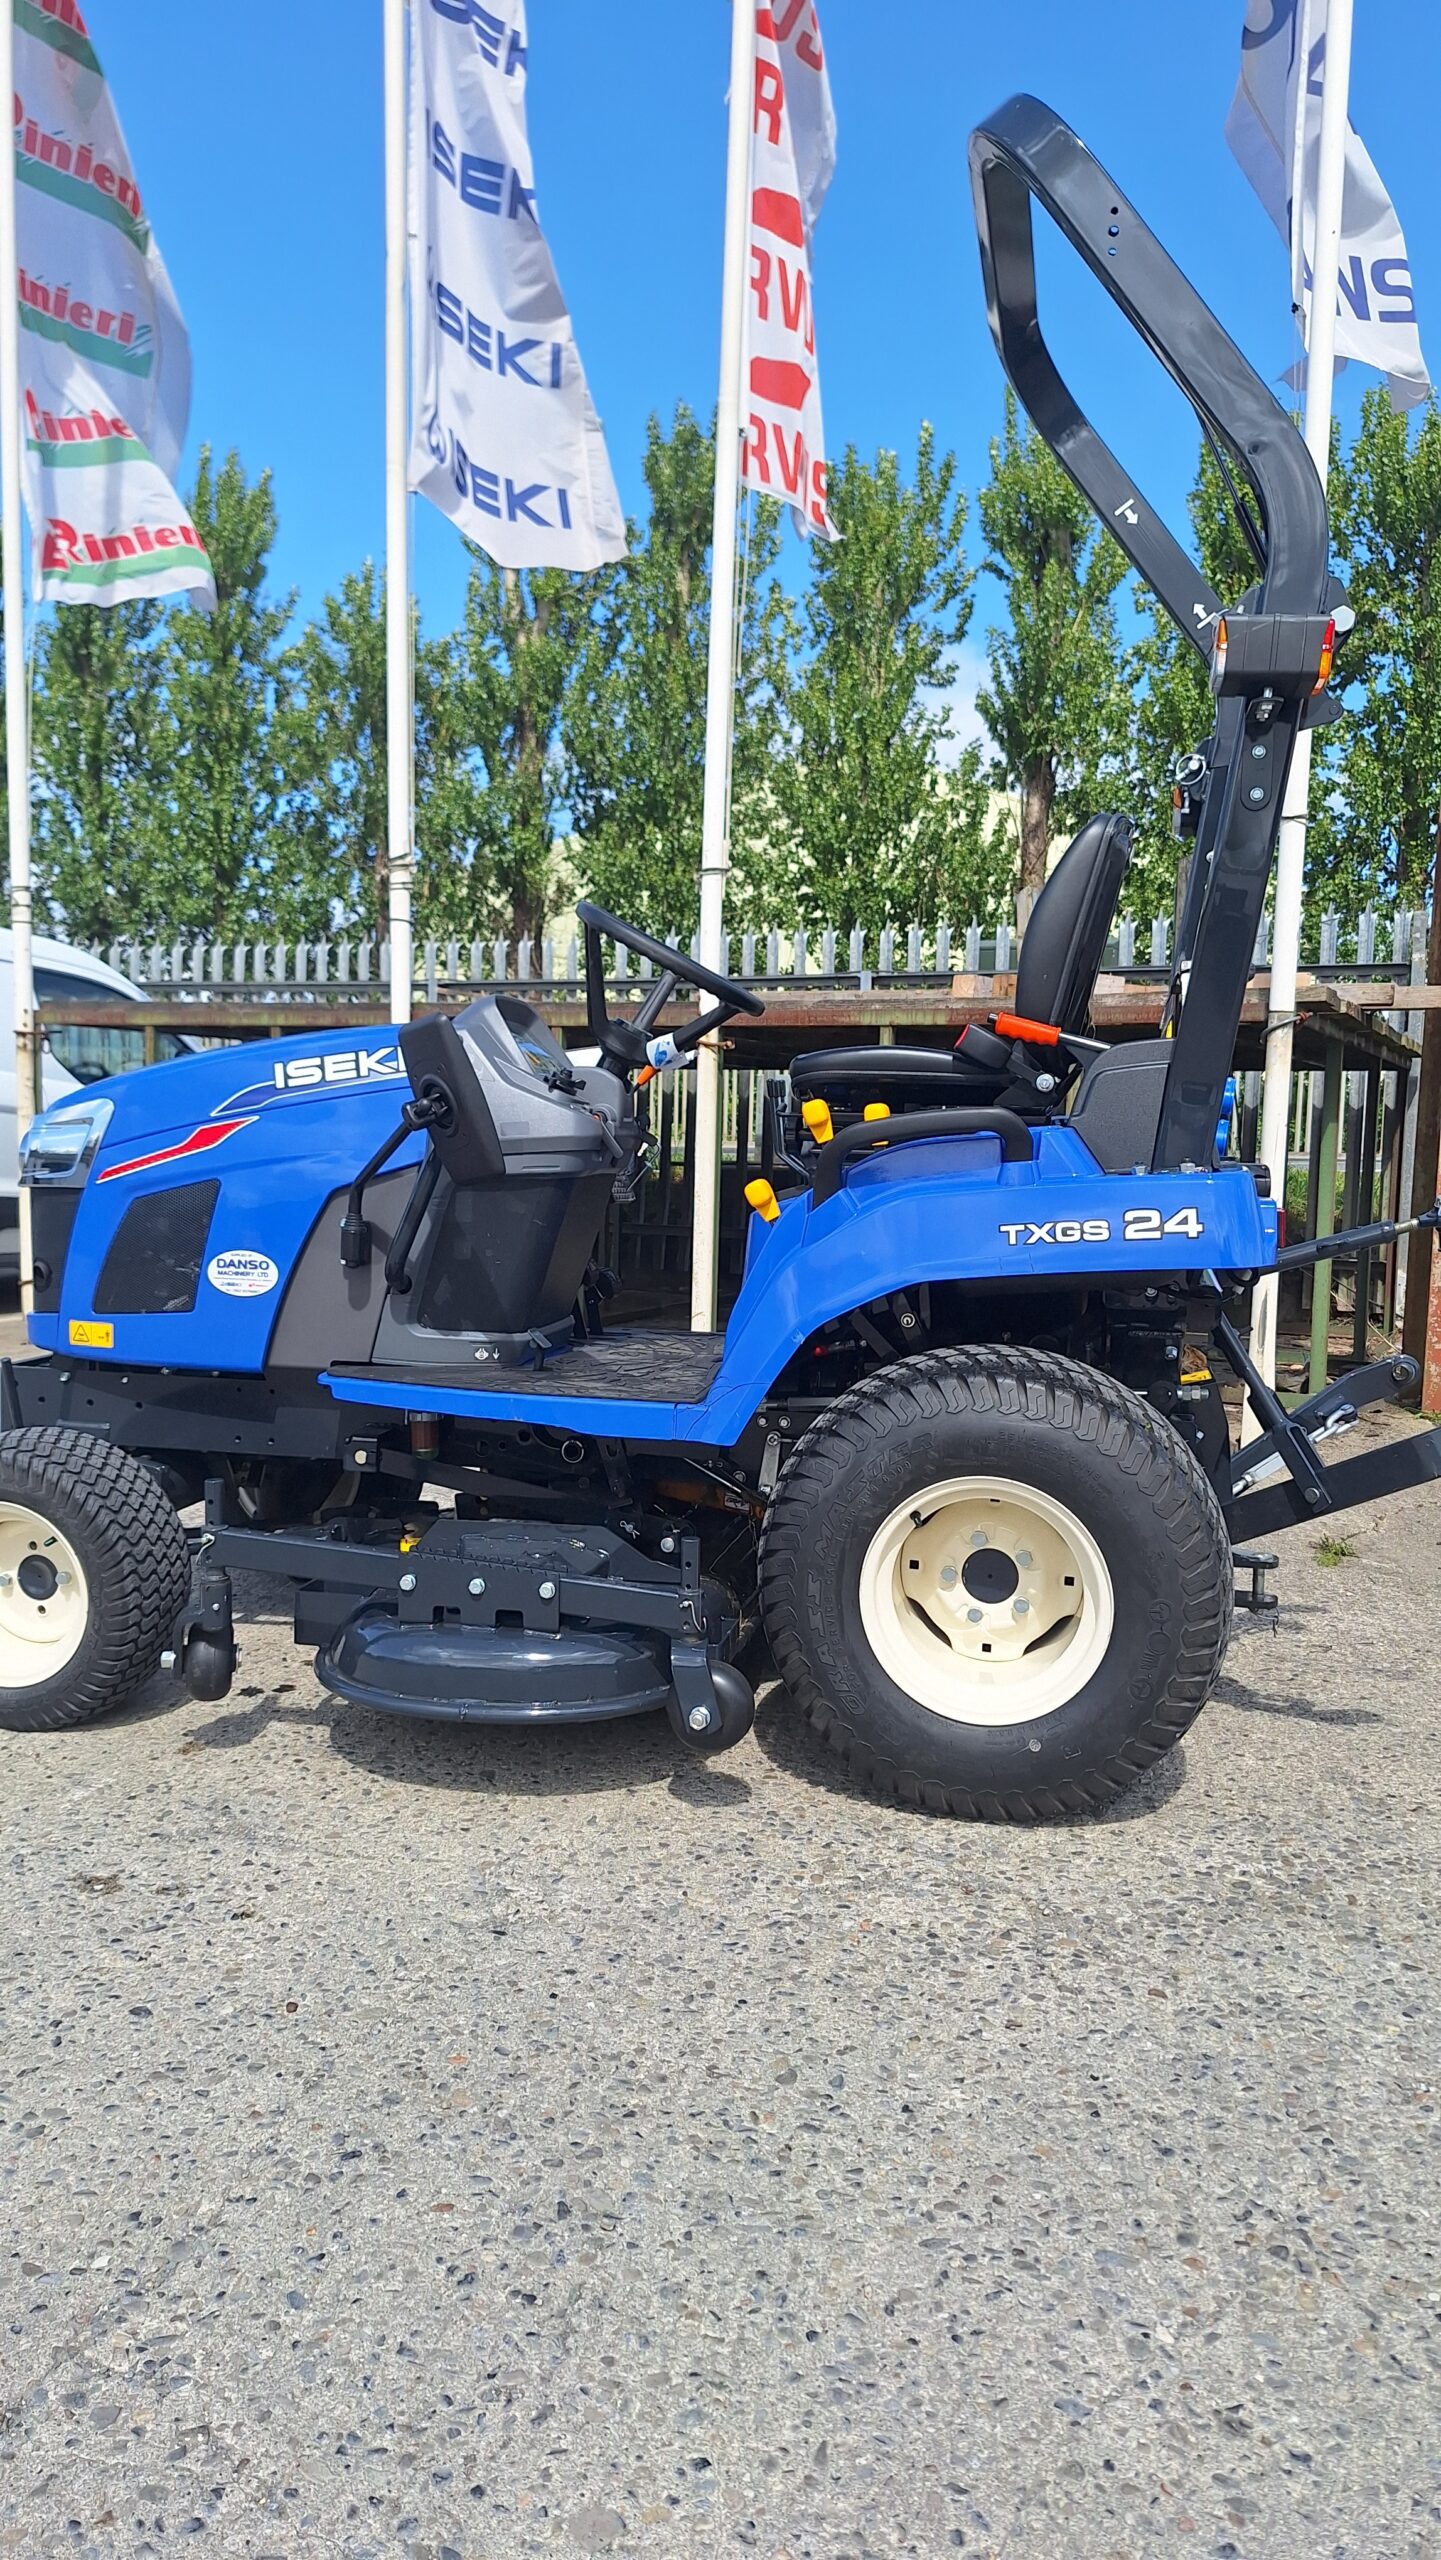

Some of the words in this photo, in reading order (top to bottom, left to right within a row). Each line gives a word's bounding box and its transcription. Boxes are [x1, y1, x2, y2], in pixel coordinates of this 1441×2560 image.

[426, 108, 537, 225] ISEK
[999, 1220, 1110, 1246] TXGS
[1123, 1207, 1204, 1242] 24
[216, 1258, 270, 1271] DANSO
[217, 1269, 256, 1278] MACHINERY
